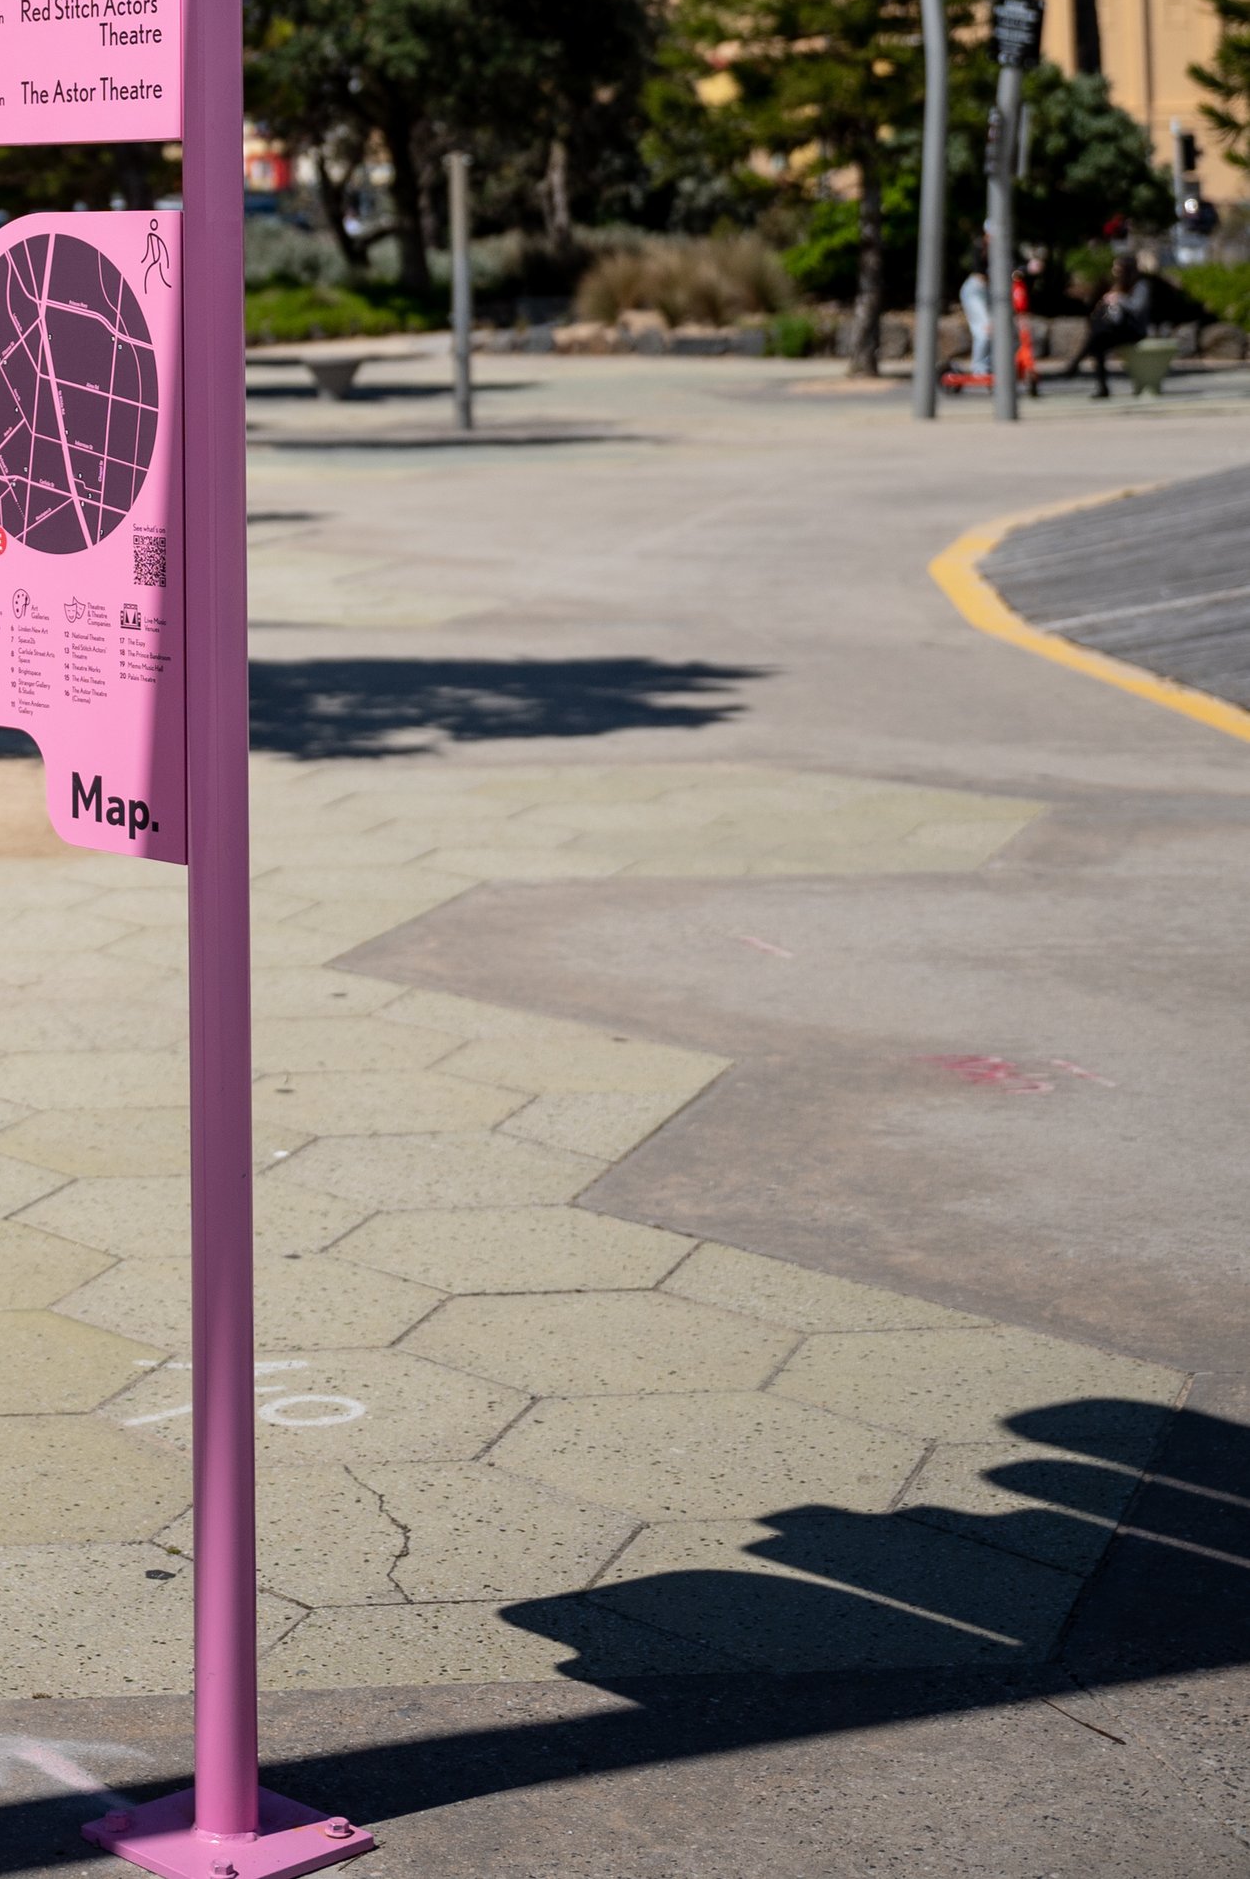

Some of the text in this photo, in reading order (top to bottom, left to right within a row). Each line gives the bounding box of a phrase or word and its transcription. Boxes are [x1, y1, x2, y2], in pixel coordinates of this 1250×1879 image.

[99, 22, 162, 47] Theatre
[21, 76, 163, 105] The Astor Theatre
[133, 523, 142, 532] See
[143, 525, 159, 533] what's
[72, 771, 159, 840] Map.
